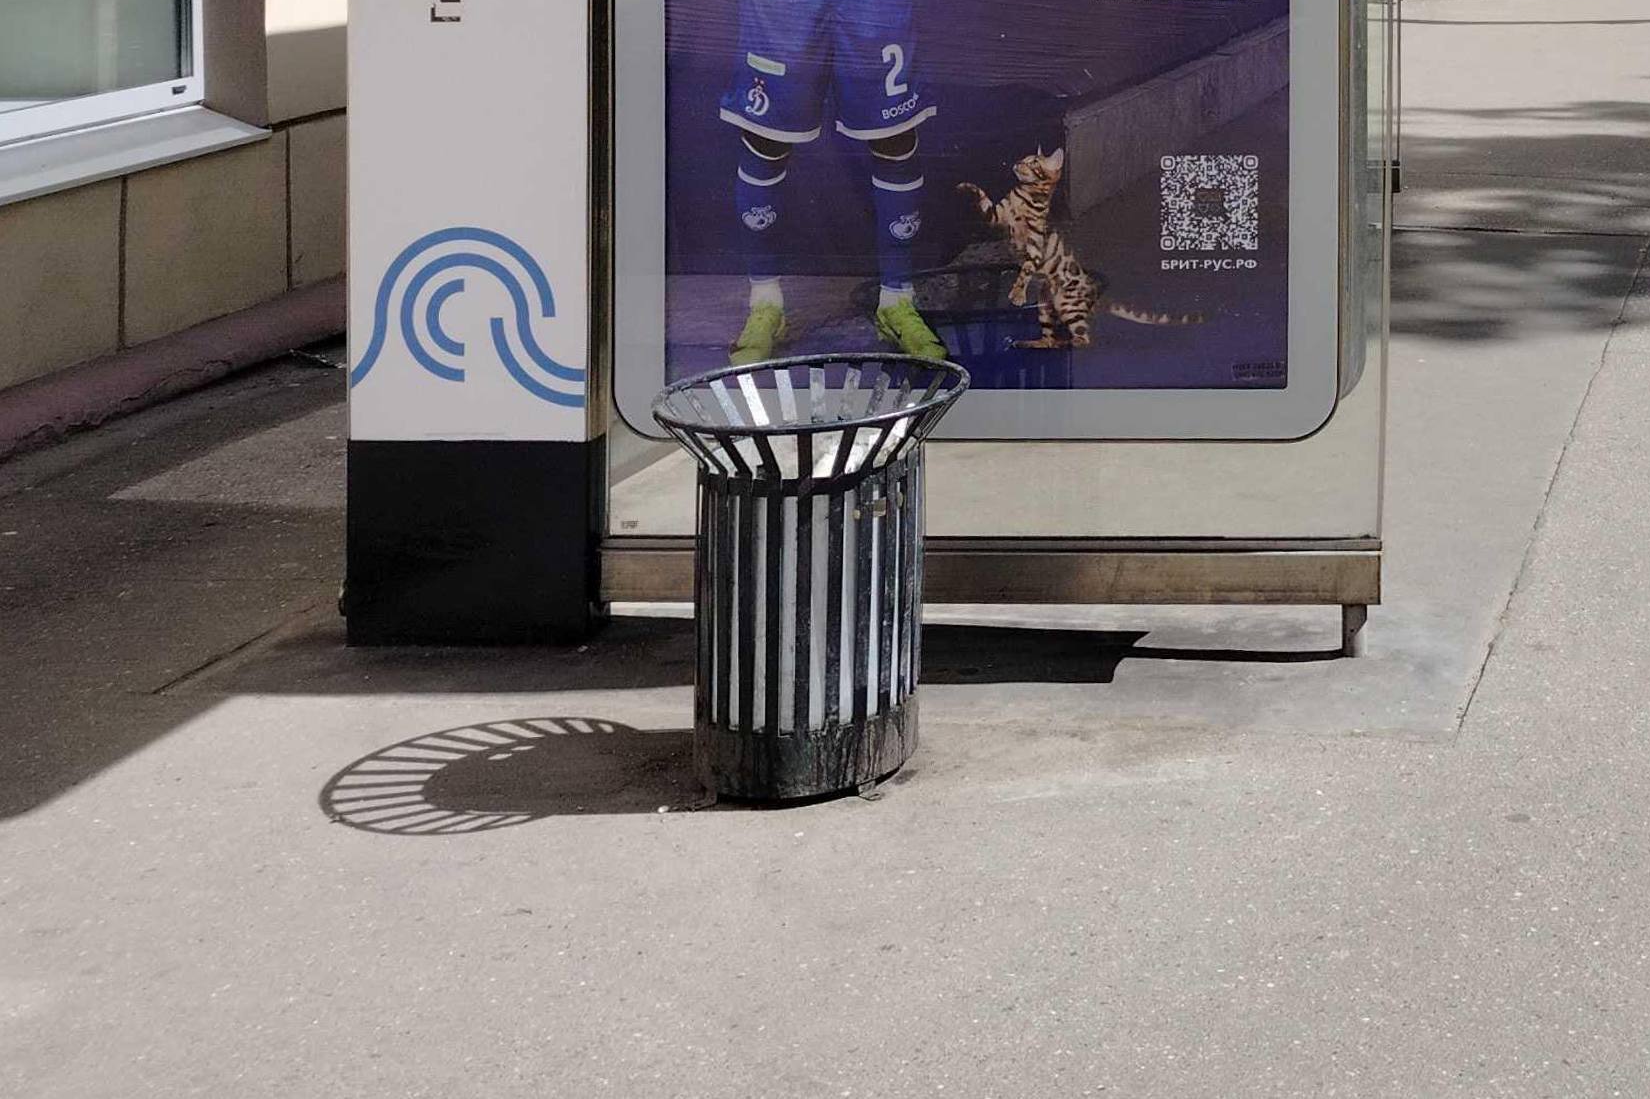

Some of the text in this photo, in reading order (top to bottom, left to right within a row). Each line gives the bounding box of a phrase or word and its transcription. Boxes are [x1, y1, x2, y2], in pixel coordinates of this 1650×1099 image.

[881, 44, 908, 96] 2
[881, 99, 916, 120] BOSCO
[1161, 258, 1258, 272] БРИТ-РУС.РФ
